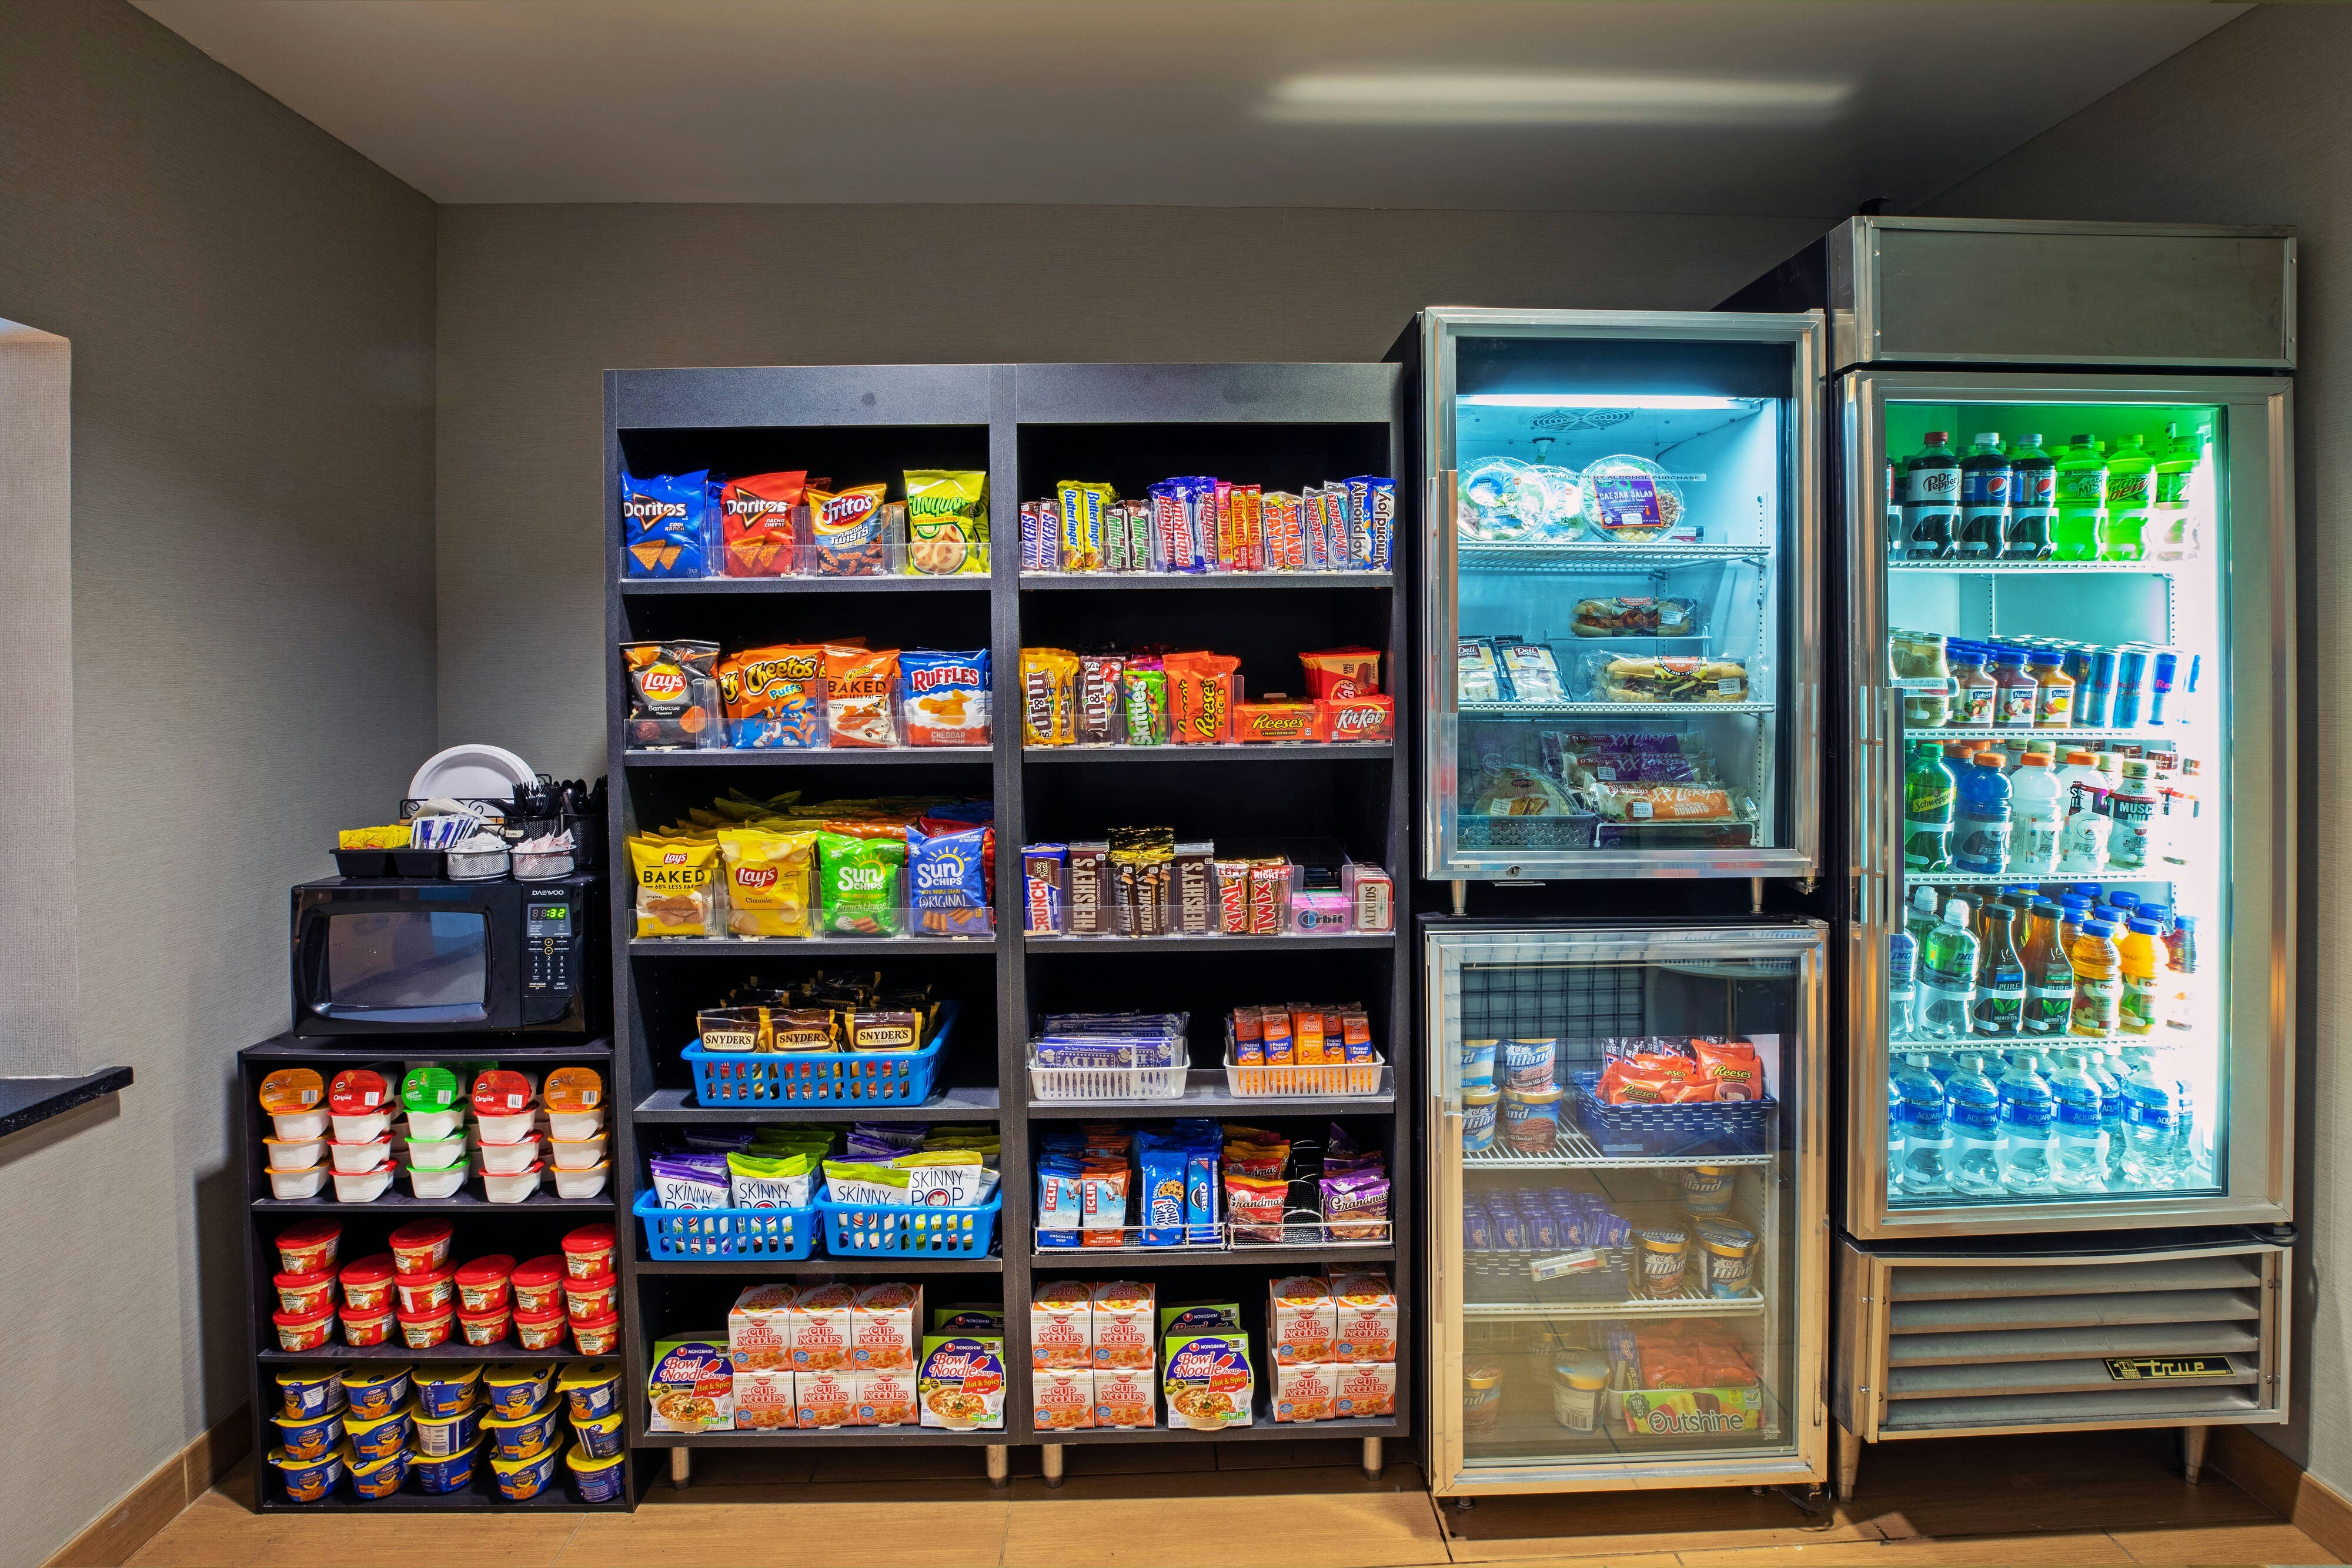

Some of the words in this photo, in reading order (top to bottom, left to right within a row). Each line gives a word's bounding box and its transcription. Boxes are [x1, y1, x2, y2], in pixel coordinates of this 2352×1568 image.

[1923, 475, 1958, 493] Pepper
[1599, 491, 1628, 500] CAESAR
[1631, 490, 1653, 498] SALAD
[623, 502, 686, 517] Doritos
[726, 500, 787, 516] Doritos
[821, 494, 873, 525] Fritos
[1351, 482, 1368, 535] Almond
[1064, 490, 1078, 547] Butterfinger
[1087, 491, 1100, 549] Butterfinger
[1232, 498, 1246, 546] Starburst
[1247, 498, 1260, 545] Starburst
[829, 526, 868, 545] TWISTS
[837, 524, 862, 538] FLAVOR
[1284, 504, 1304, 566] PAYDAY
[1022, 514, 1038, 568] SNICKERS
[1040, 514, 1057, 568] SNICKERS
[1351, 534, 1365, 559] Joy
[644, 673, 684, 693] Lay's
[744, 657, 815, 696] Cheetos
[845, 666, 871, 682] Cheetos
[913, 667, 979, 691] RUFFLES
[770, 684, 803, 700] Puffs
[828, 680, 886, 693] BAKED
[2053, 690, 2070, 698] Naked
[1133, 680, 1154, 746] skittles
[1194, 678, 1215, 738] Reese's
[1252, 714, 1305, 730] Reese's
[1337, 709, 1383, 730] KitKat
[931, 731, 965, 739] CHEDDAR
[1916, 791, 1950, 811] Schweppe
[1675, 806, 1709, 816] BURRITO
[664, 852, 686, 864] Lay's
[644, 870, 704, 882] BAKED
[739, 866, 775, 888] Lay's
[838, 864, 886, 891] Sun
[917, 858, 964, 888] Sun
[1040, 861, 1049, 878] Real
[1254, 870, 1279, 880] RIGHT
[854, 882, 883, 891] CHIPS
[932, 877, 963, 886] CHIPS
[919, 894, 971, 908] ORIGINAL
[1073, 858, 1096, 928] HERSHEY'S
[1181, 862, 1204, 930] HERSHEY'S
[1031, 880, 1050, 931] CRUNCH
[1365, 886, 1377, 926] ALTOIDS
[1297, 910, 1345, 930] Orbit
[706, 1034, 751, 1045] SNYDER'S
[780, 1032, 828, 1044] SNYDER'S
[860, 1029, 908, 1041] SNYDER'S
[1063, 1056, 1090, 1067] ACT
[1093, 1057, 1109, 1067] II
[1506, 1045, 1553, 1066] Hiland
[1714, 1065, 1752, 1078] Reese's
[1621, 1084, 1659, 1099] Reese's
[1966, 1114, 1997, 1122] AQUAFINA
[912, 1168, 963, 1188] SKINNY
[666, 1182, 713, 1205] SKINNY
[739, 1181, 790, 1199] SKINNY
[837, 1183, 891, 1205] SKINNY
[911, 1187, 964, 1206] POP
[1047, 1181, 1058, 1202] CLIF
[1152, 1179, 1165, 1199] ORIGINAL
[1199, 1182, 1208, 1213] OREO
[1229, 1196, 1285, 1209] Grandma's
[1330, 1189, 1388, 1212] Grandma's
[747, 1327, 773, 1337] CUP
[869, 1326, 894, 1336] CUP
[1285, 1328, 1328, 1338] NOODLES
[1295, 1320, 1320, 1329] CUP
[737, 1336, 782, 1346] NOODLES
[859, 1335, 904, 1345] NOODLES
[665, 1356, 702, 1370] Bowl
[660, 1367, 708, 1382] Noodle
[697, 1383, 709, 1392] Hot
[715, 1380, 731, 1392] Spicy
[1648, 1409, 1744, 1433] Outshine
